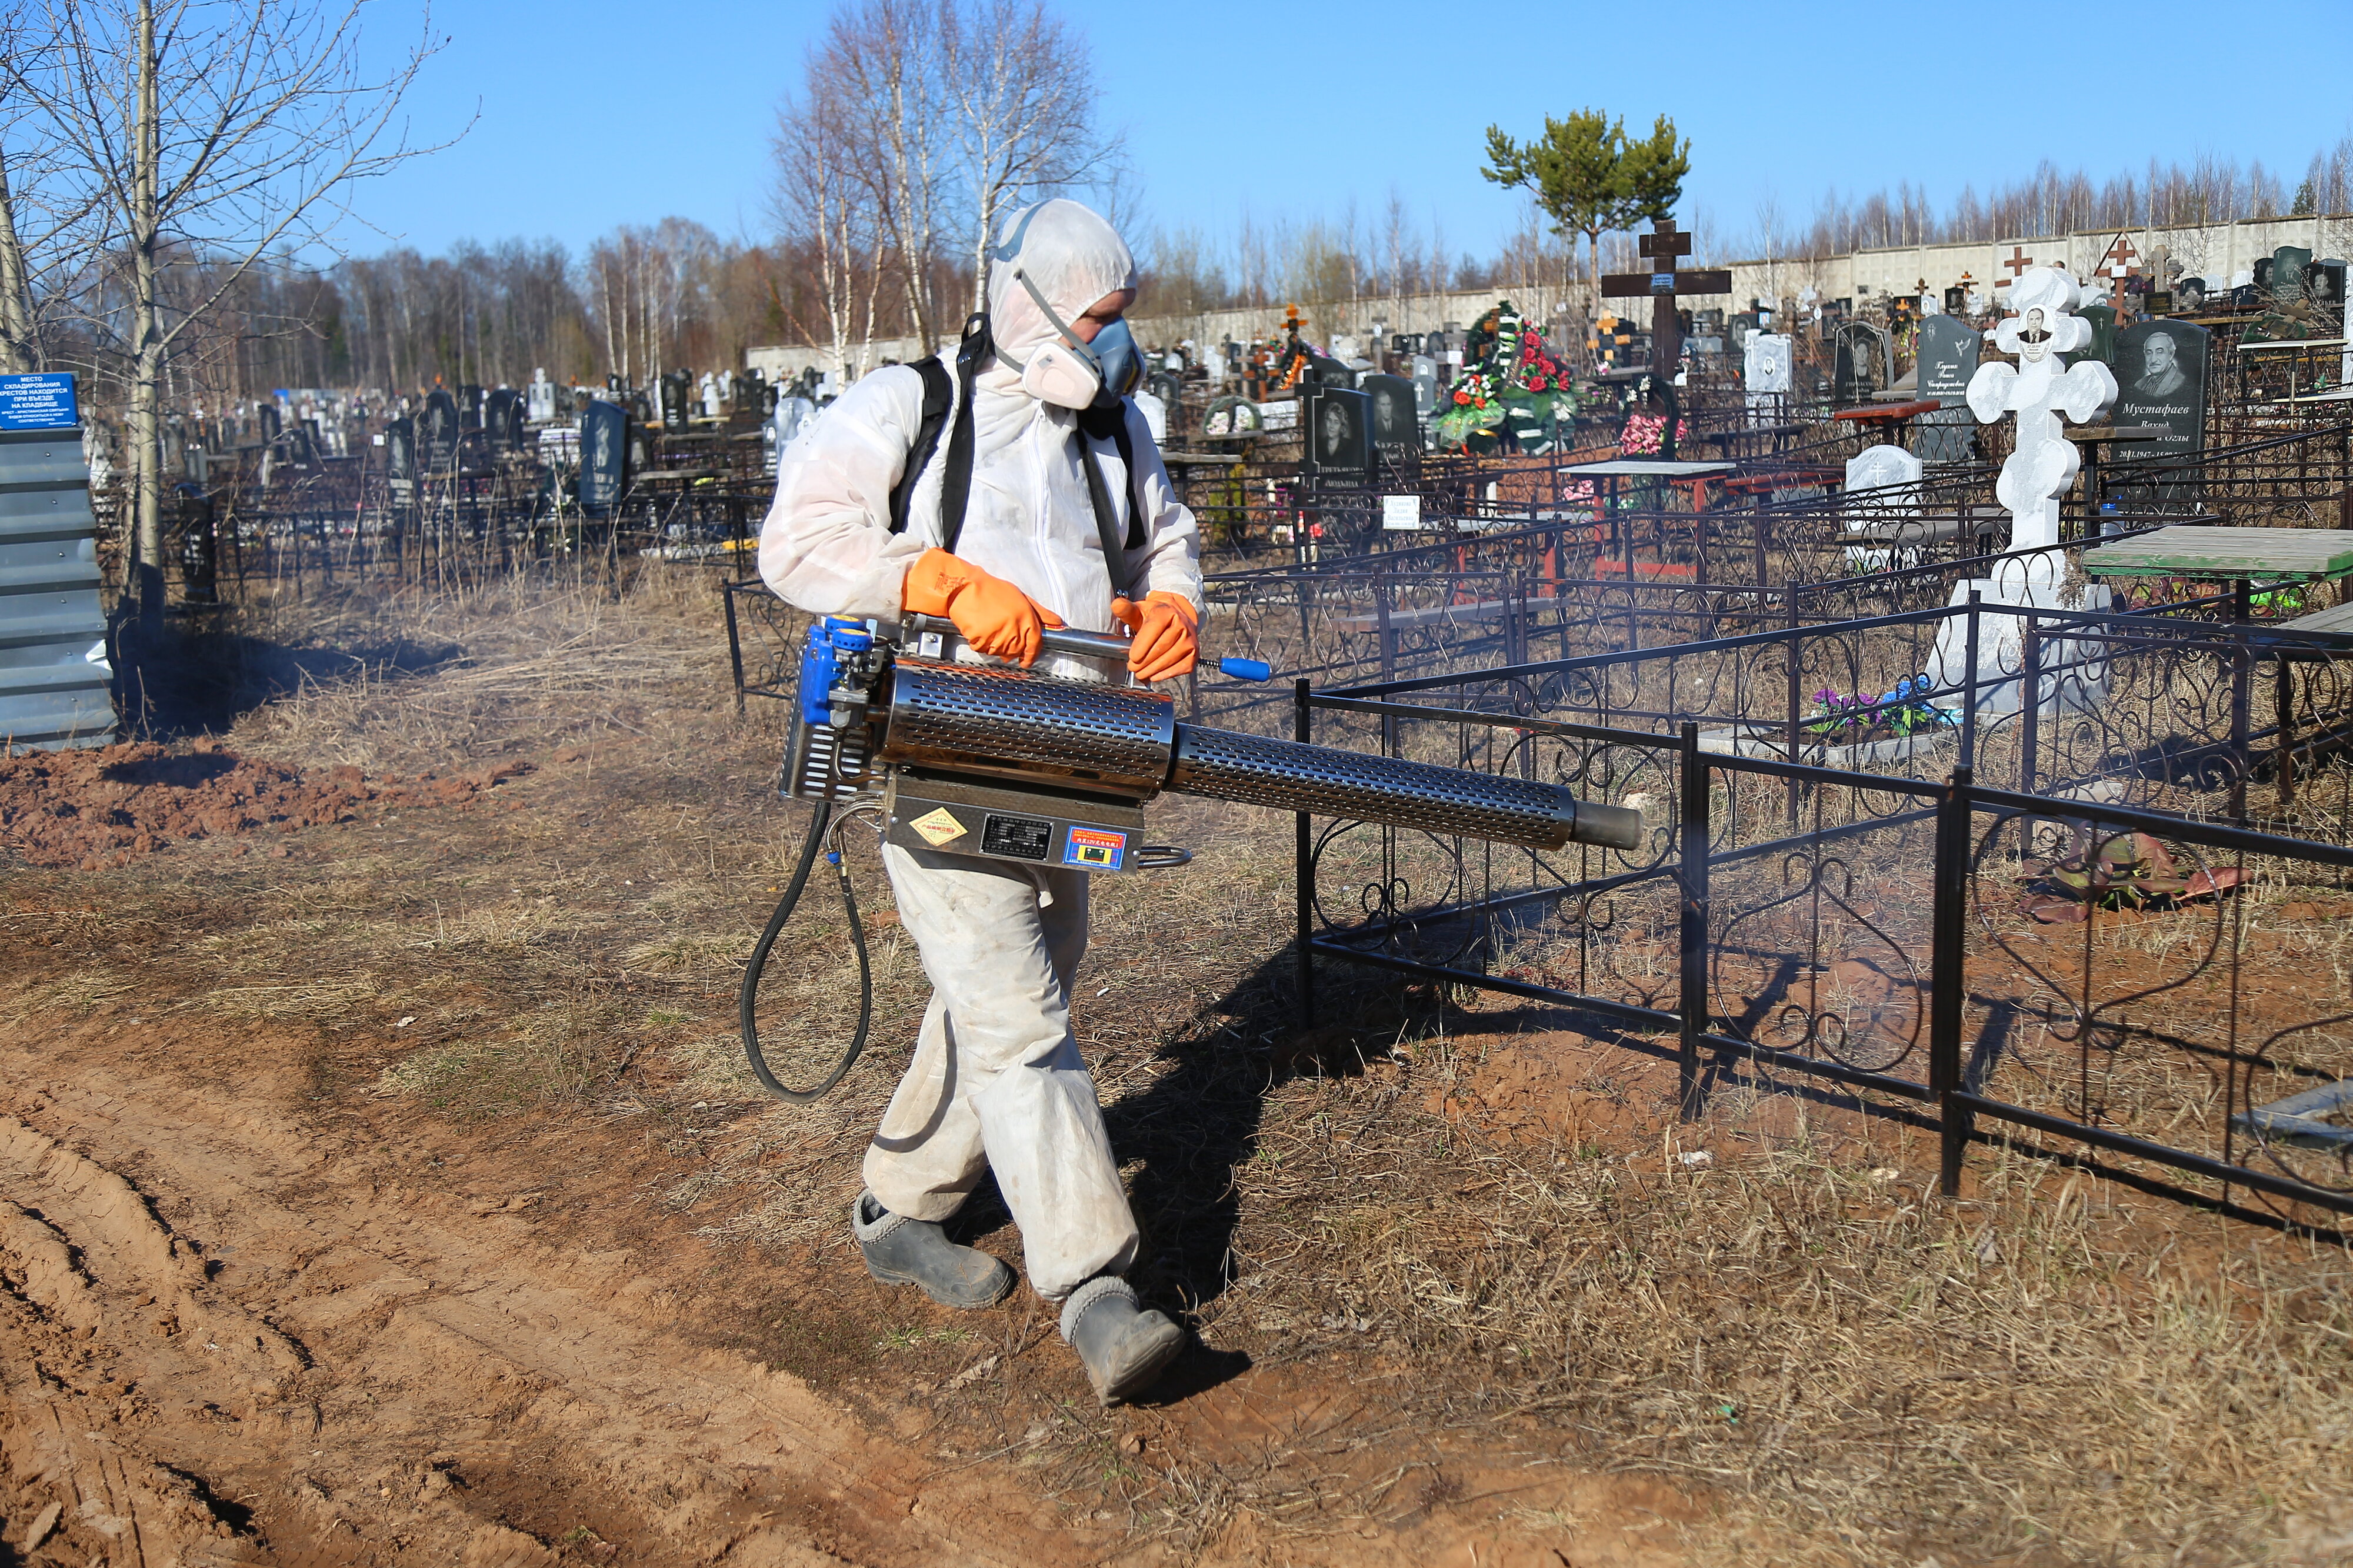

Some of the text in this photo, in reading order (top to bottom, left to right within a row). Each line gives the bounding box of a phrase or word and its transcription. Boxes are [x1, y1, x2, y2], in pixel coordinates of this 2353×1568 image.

[4, 381, 61, 389] СКЛАДИРОВАНИЯ
[2122, 403, 2189, 416] Мустафаев
[2119, 450, 2151, 458] 20.1.1947
